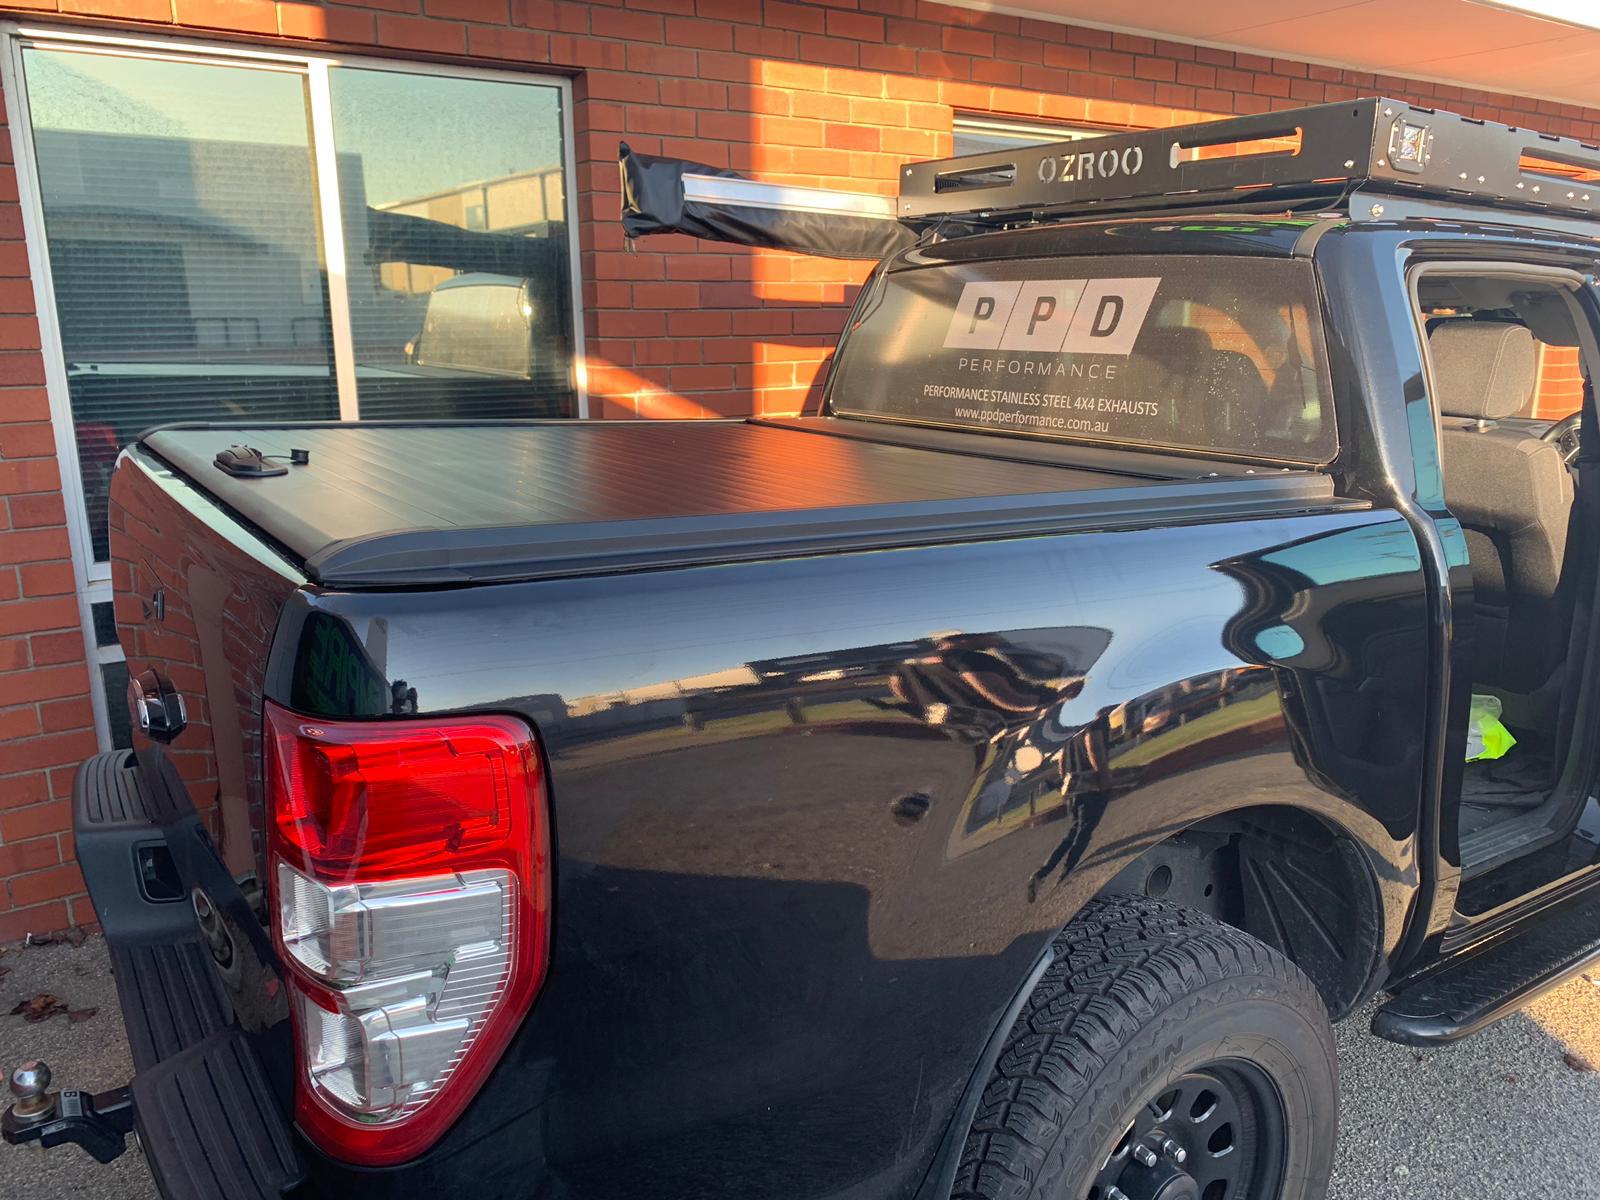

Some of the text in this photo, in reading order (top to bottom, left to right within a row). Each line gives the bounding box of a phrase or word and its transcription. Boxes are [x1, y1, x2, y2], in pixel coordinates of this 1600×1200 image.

[1038, 146, 1143, 184] OZROO
[968, 295, 1124, 337] PPD
[958, 358, 1117, 379] PERFORMANCE
[923, 384, 1158, 416] PERFORMANCE STAINLESS STEEL 4X4 EXHAUSTS
[954, 407, 1110, 433] www.ppdperformance.com.au
